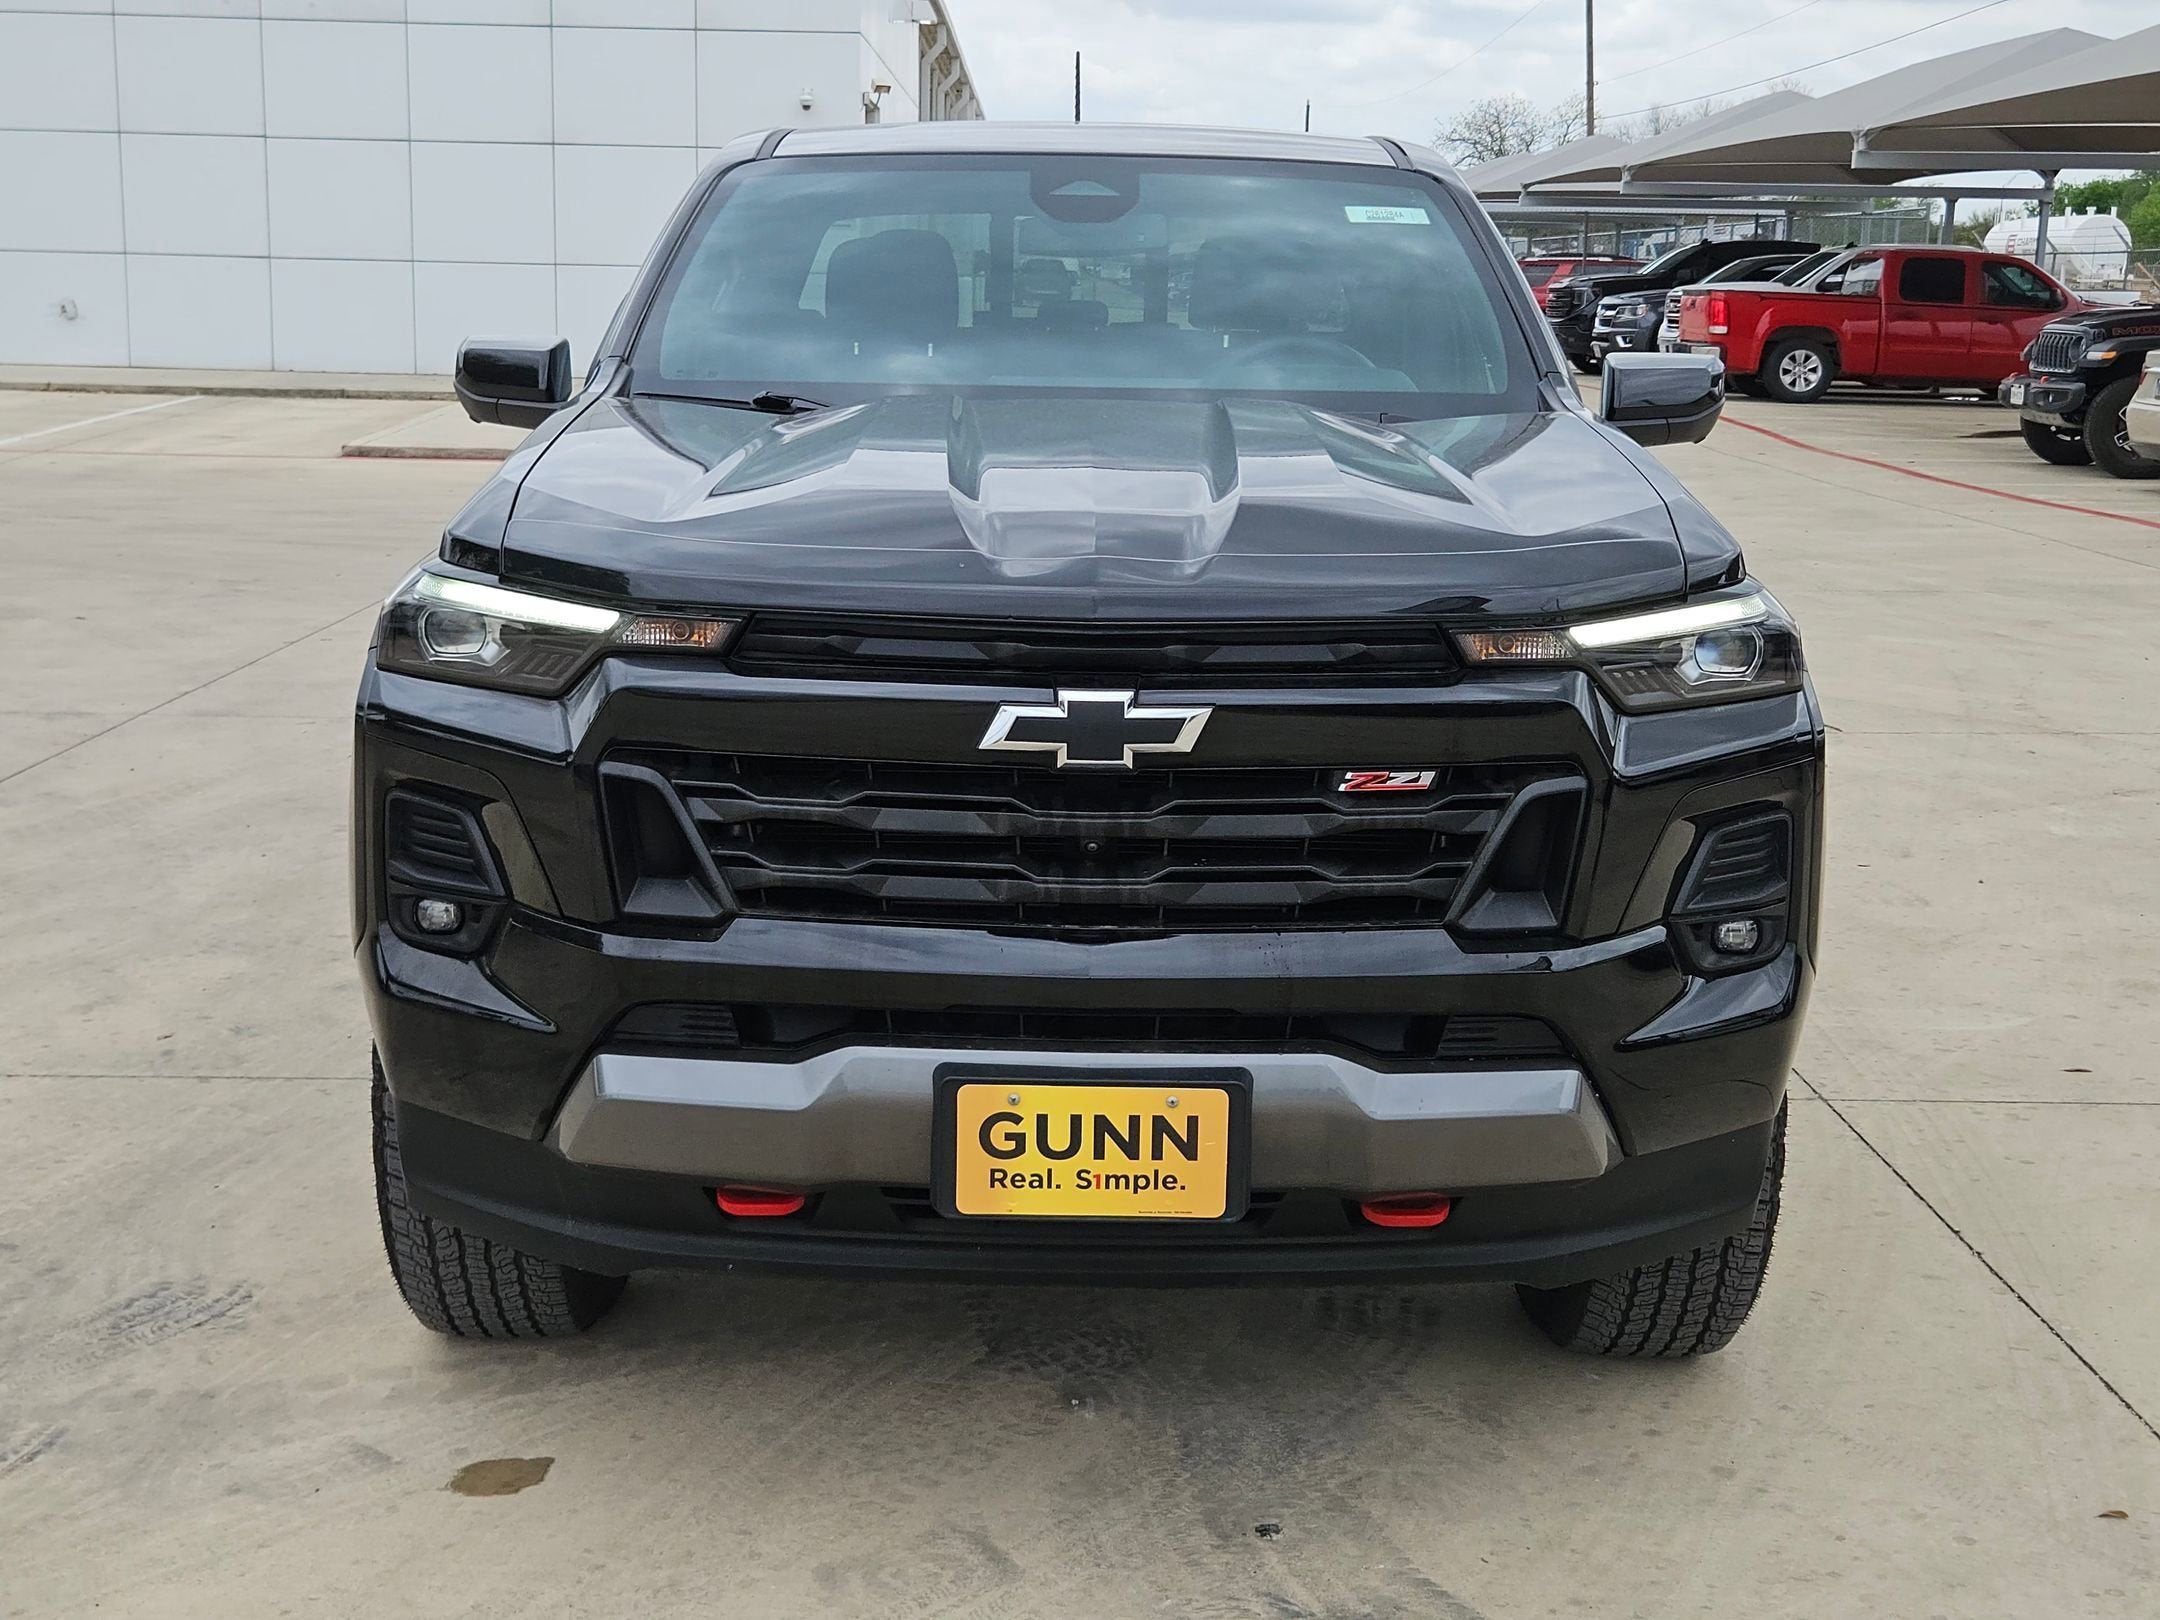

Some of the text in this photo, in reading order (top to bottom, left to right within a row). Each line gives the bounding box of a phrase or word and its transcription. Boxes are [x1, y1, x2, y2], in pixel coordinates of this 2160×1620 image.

[1338, 771, 1436, 791] Z71
[978, 1111, 1199, 1162] GUNN
[989, 1168, 1061, 1190] Real.
